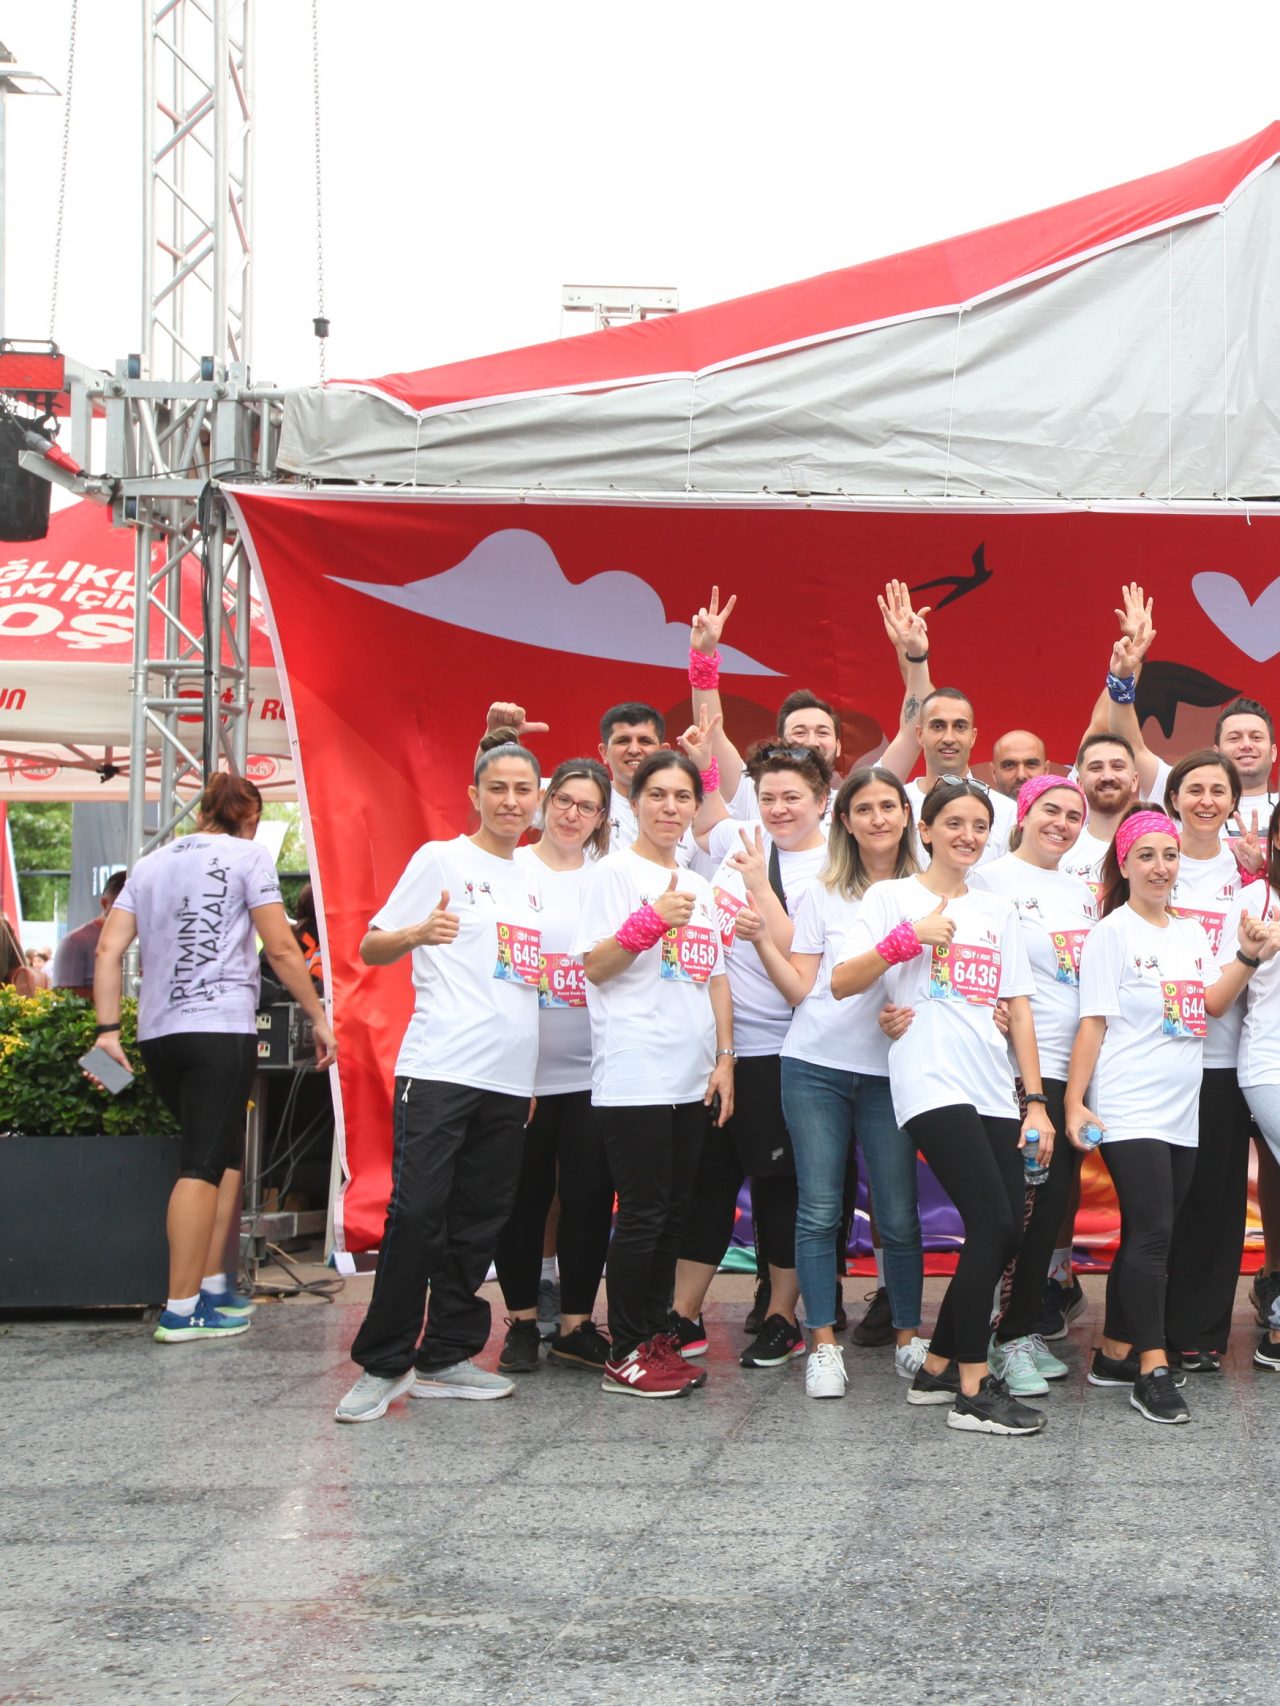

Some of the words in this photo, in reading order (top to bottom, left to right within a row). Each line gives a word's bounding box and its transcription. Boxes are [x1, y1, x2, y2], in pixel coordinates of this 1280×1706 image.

[0, 558, 140, 592] ĞLIKL
[0, 603, 134, 649] OŞ
[513, 942, 541, 967] 645
[681, 941, 715, 966] 6458
[553, 969, 586, 990] 643
[953, 961, 998, 988] 6436
[1182, 997, 1205, 1019] 644
